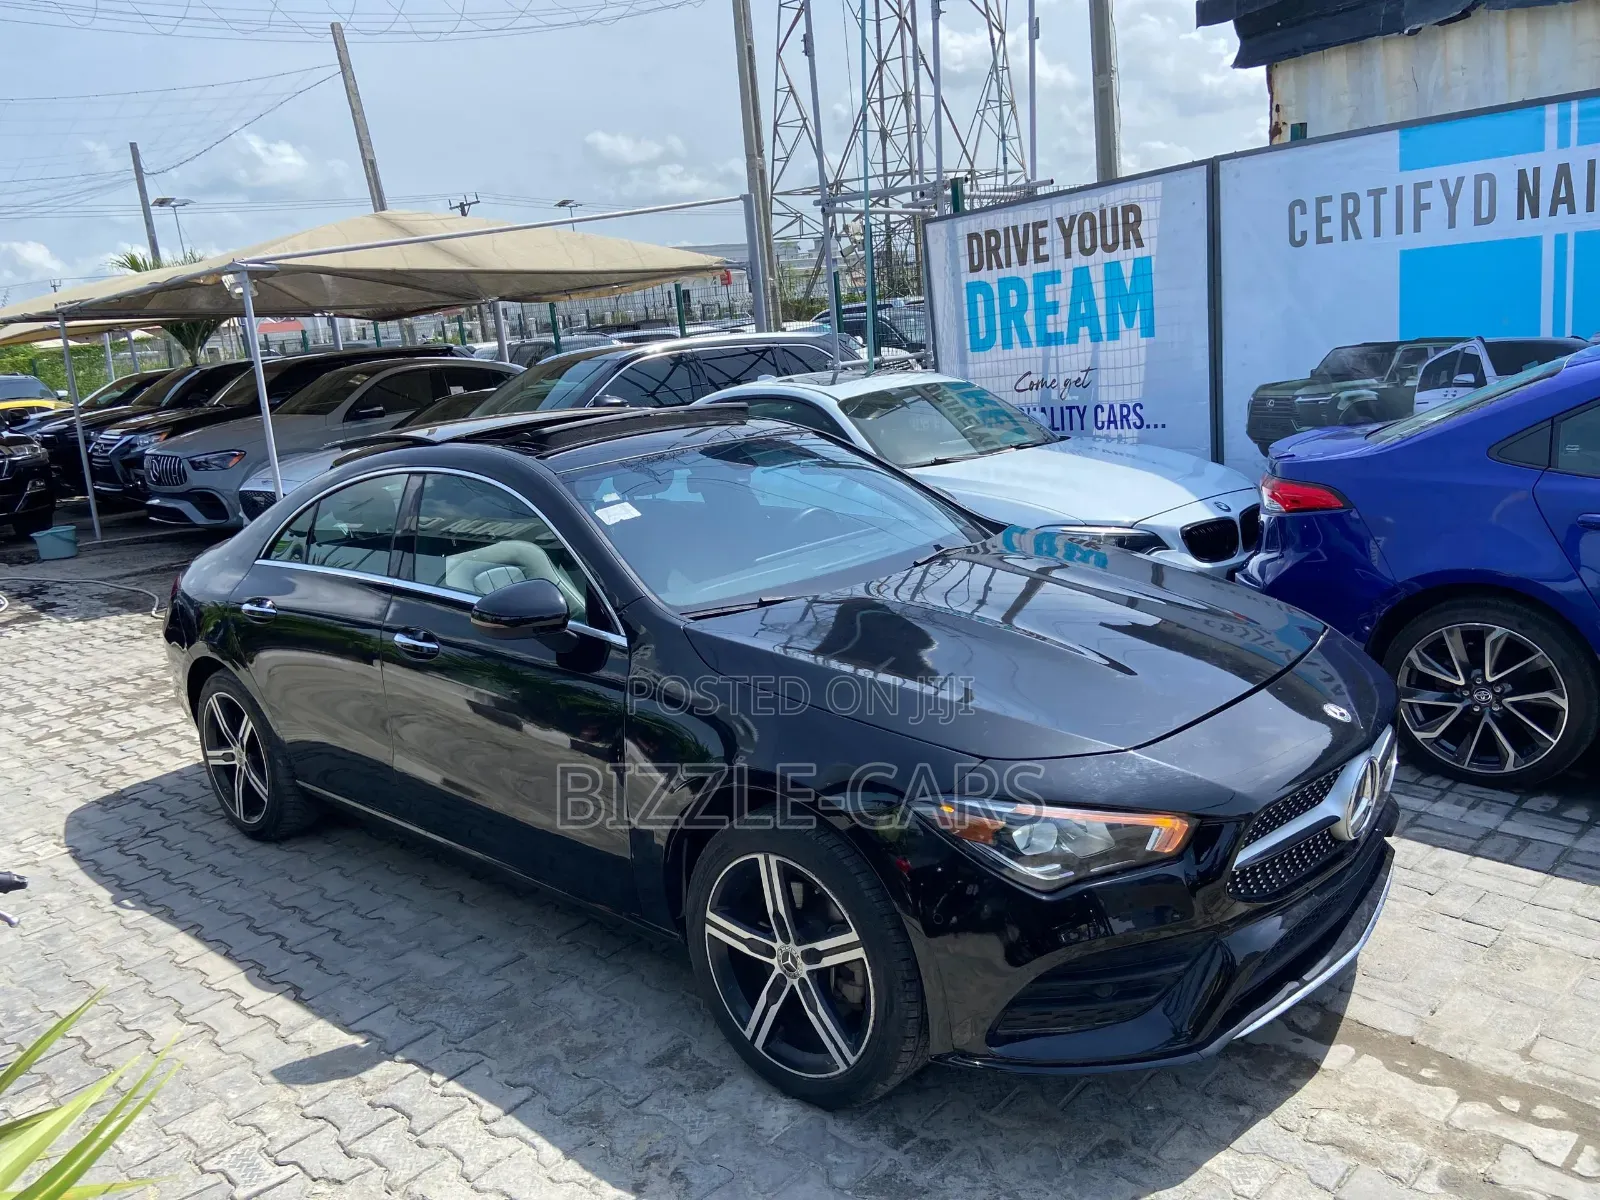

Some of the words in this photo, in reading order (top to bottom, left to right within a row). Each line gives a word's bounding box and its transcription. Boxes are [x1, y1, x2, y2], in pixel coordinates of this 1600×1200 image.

[967, 220, 1049, 273] DRIVE
[1056, 204, 1144, 259] YOUR
[1288, 172, 1496, 249] CERTIFYD
[966, 256, 1155, 352] DREAM
[1014, 371, 1057, 393] Come
[1059, 367, 1098, 400] get
[1019, 405, 1087, 431] LITY
[1094, 402, 1166, 429] CARS...
